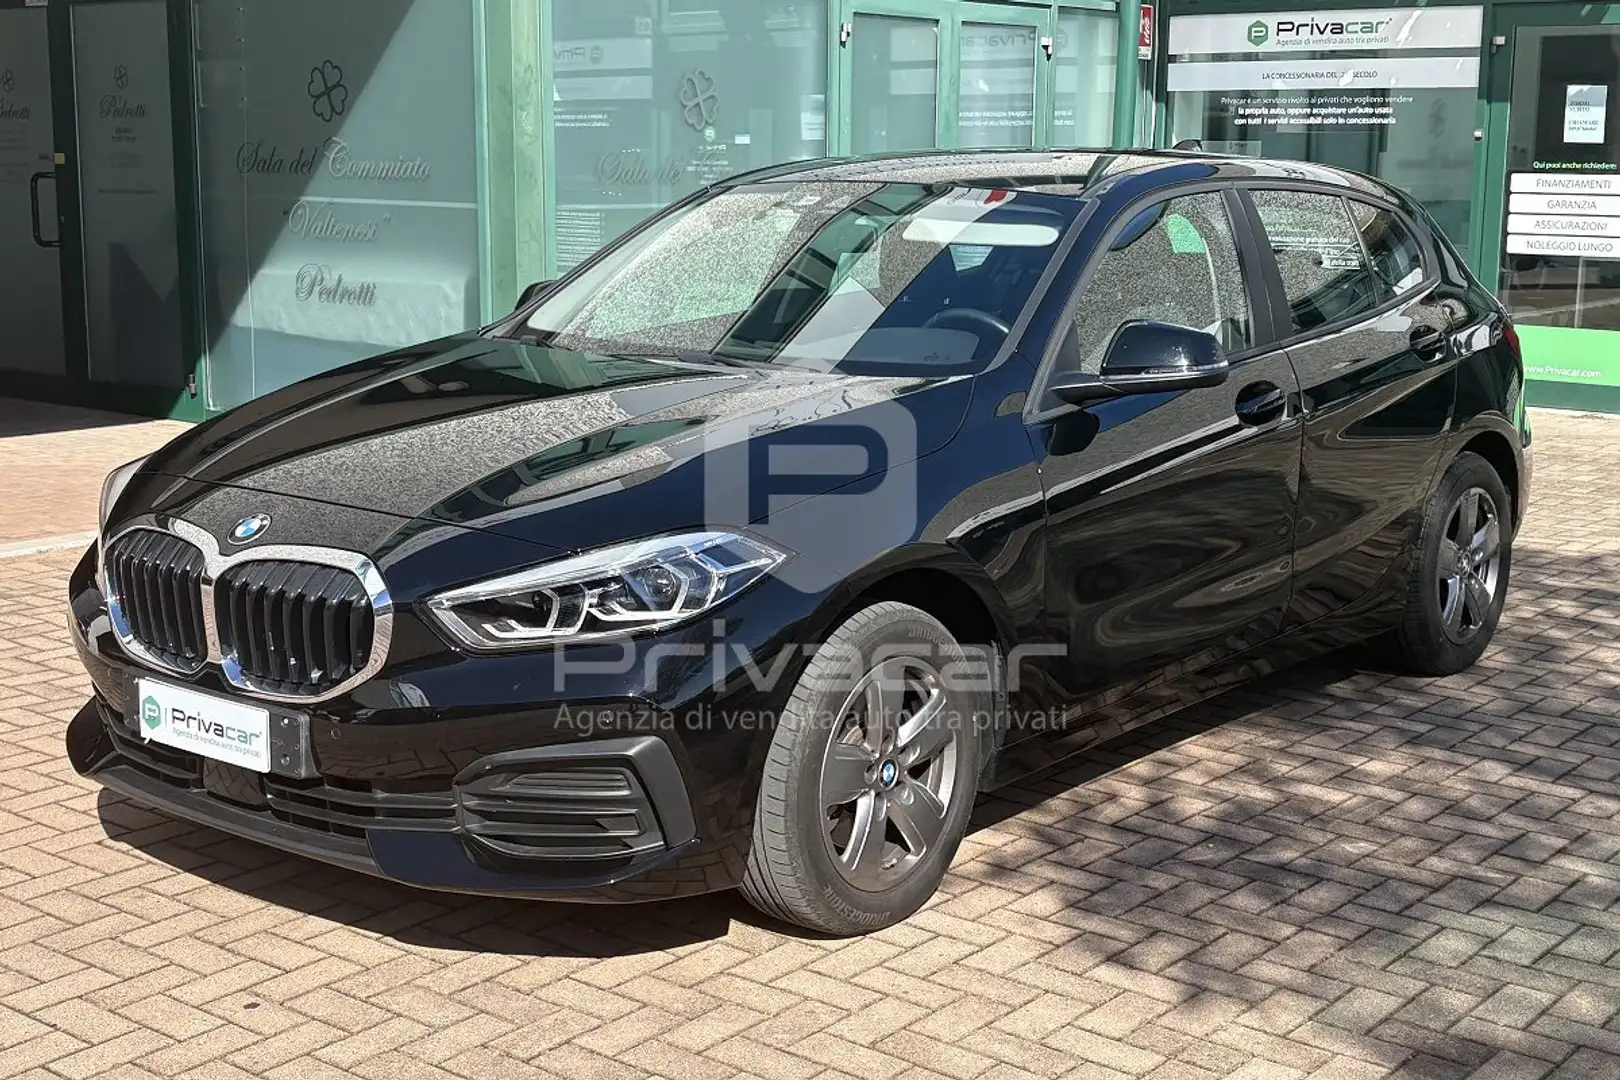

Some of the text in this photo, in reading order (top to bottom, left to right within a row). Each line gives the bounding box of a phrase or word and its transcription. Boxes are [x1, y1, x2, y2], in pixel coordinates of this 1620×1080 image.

[1276, 17, 1385, 36] Privacar
[1338, 37, 1354, 45] auto
[1366, 36, 1389, 44] privati
[1262, 72, 1270, 80] LA
[1270, 71, 1325, 79] CONCESSIONARIA
[1353, 70, 1378, 78] SECOLO
[1310, 96, 1317, 104] ai
[1317, 96, 1339, 105] privati
[1340, 96, 1352, 104] che
[1353, 95, 1383, 105] vogliono
[1385, 95, 1413, 103] vendere
[99, 94, 147, 119] Pedrotti
[1238, 107, 1244, 115] la
[1245, 107, 1268, 116] propria
[1287, 107, 1311, 116] oppure
[1312, 106, 1346, 116] acquistare
[1374, 106, 1393, 114] usata
[1247, 117, 1262, 125] tutti
[1289, 116, 1322, 124] accessibili
[1346, 116, 1396, 124] concessionaria
[236, 136, 432, 183] Sala del Commiato
[1533, 161, 1546, 169] Qui
[1546, 161, 1560, 170] puoi
[1536, 179, 1612, 189] FINANZIAMENTI
[1547, 200, 1597, 210] GARANZIA
[1534, 220, 1608, 231] ASSICURAZIONI
[1527, 240, 1613, 252] NOLEGGIO LUNGO
[295, 263, 377, 306] Pedrotti
[171, 707, 261, 746] Privacar
